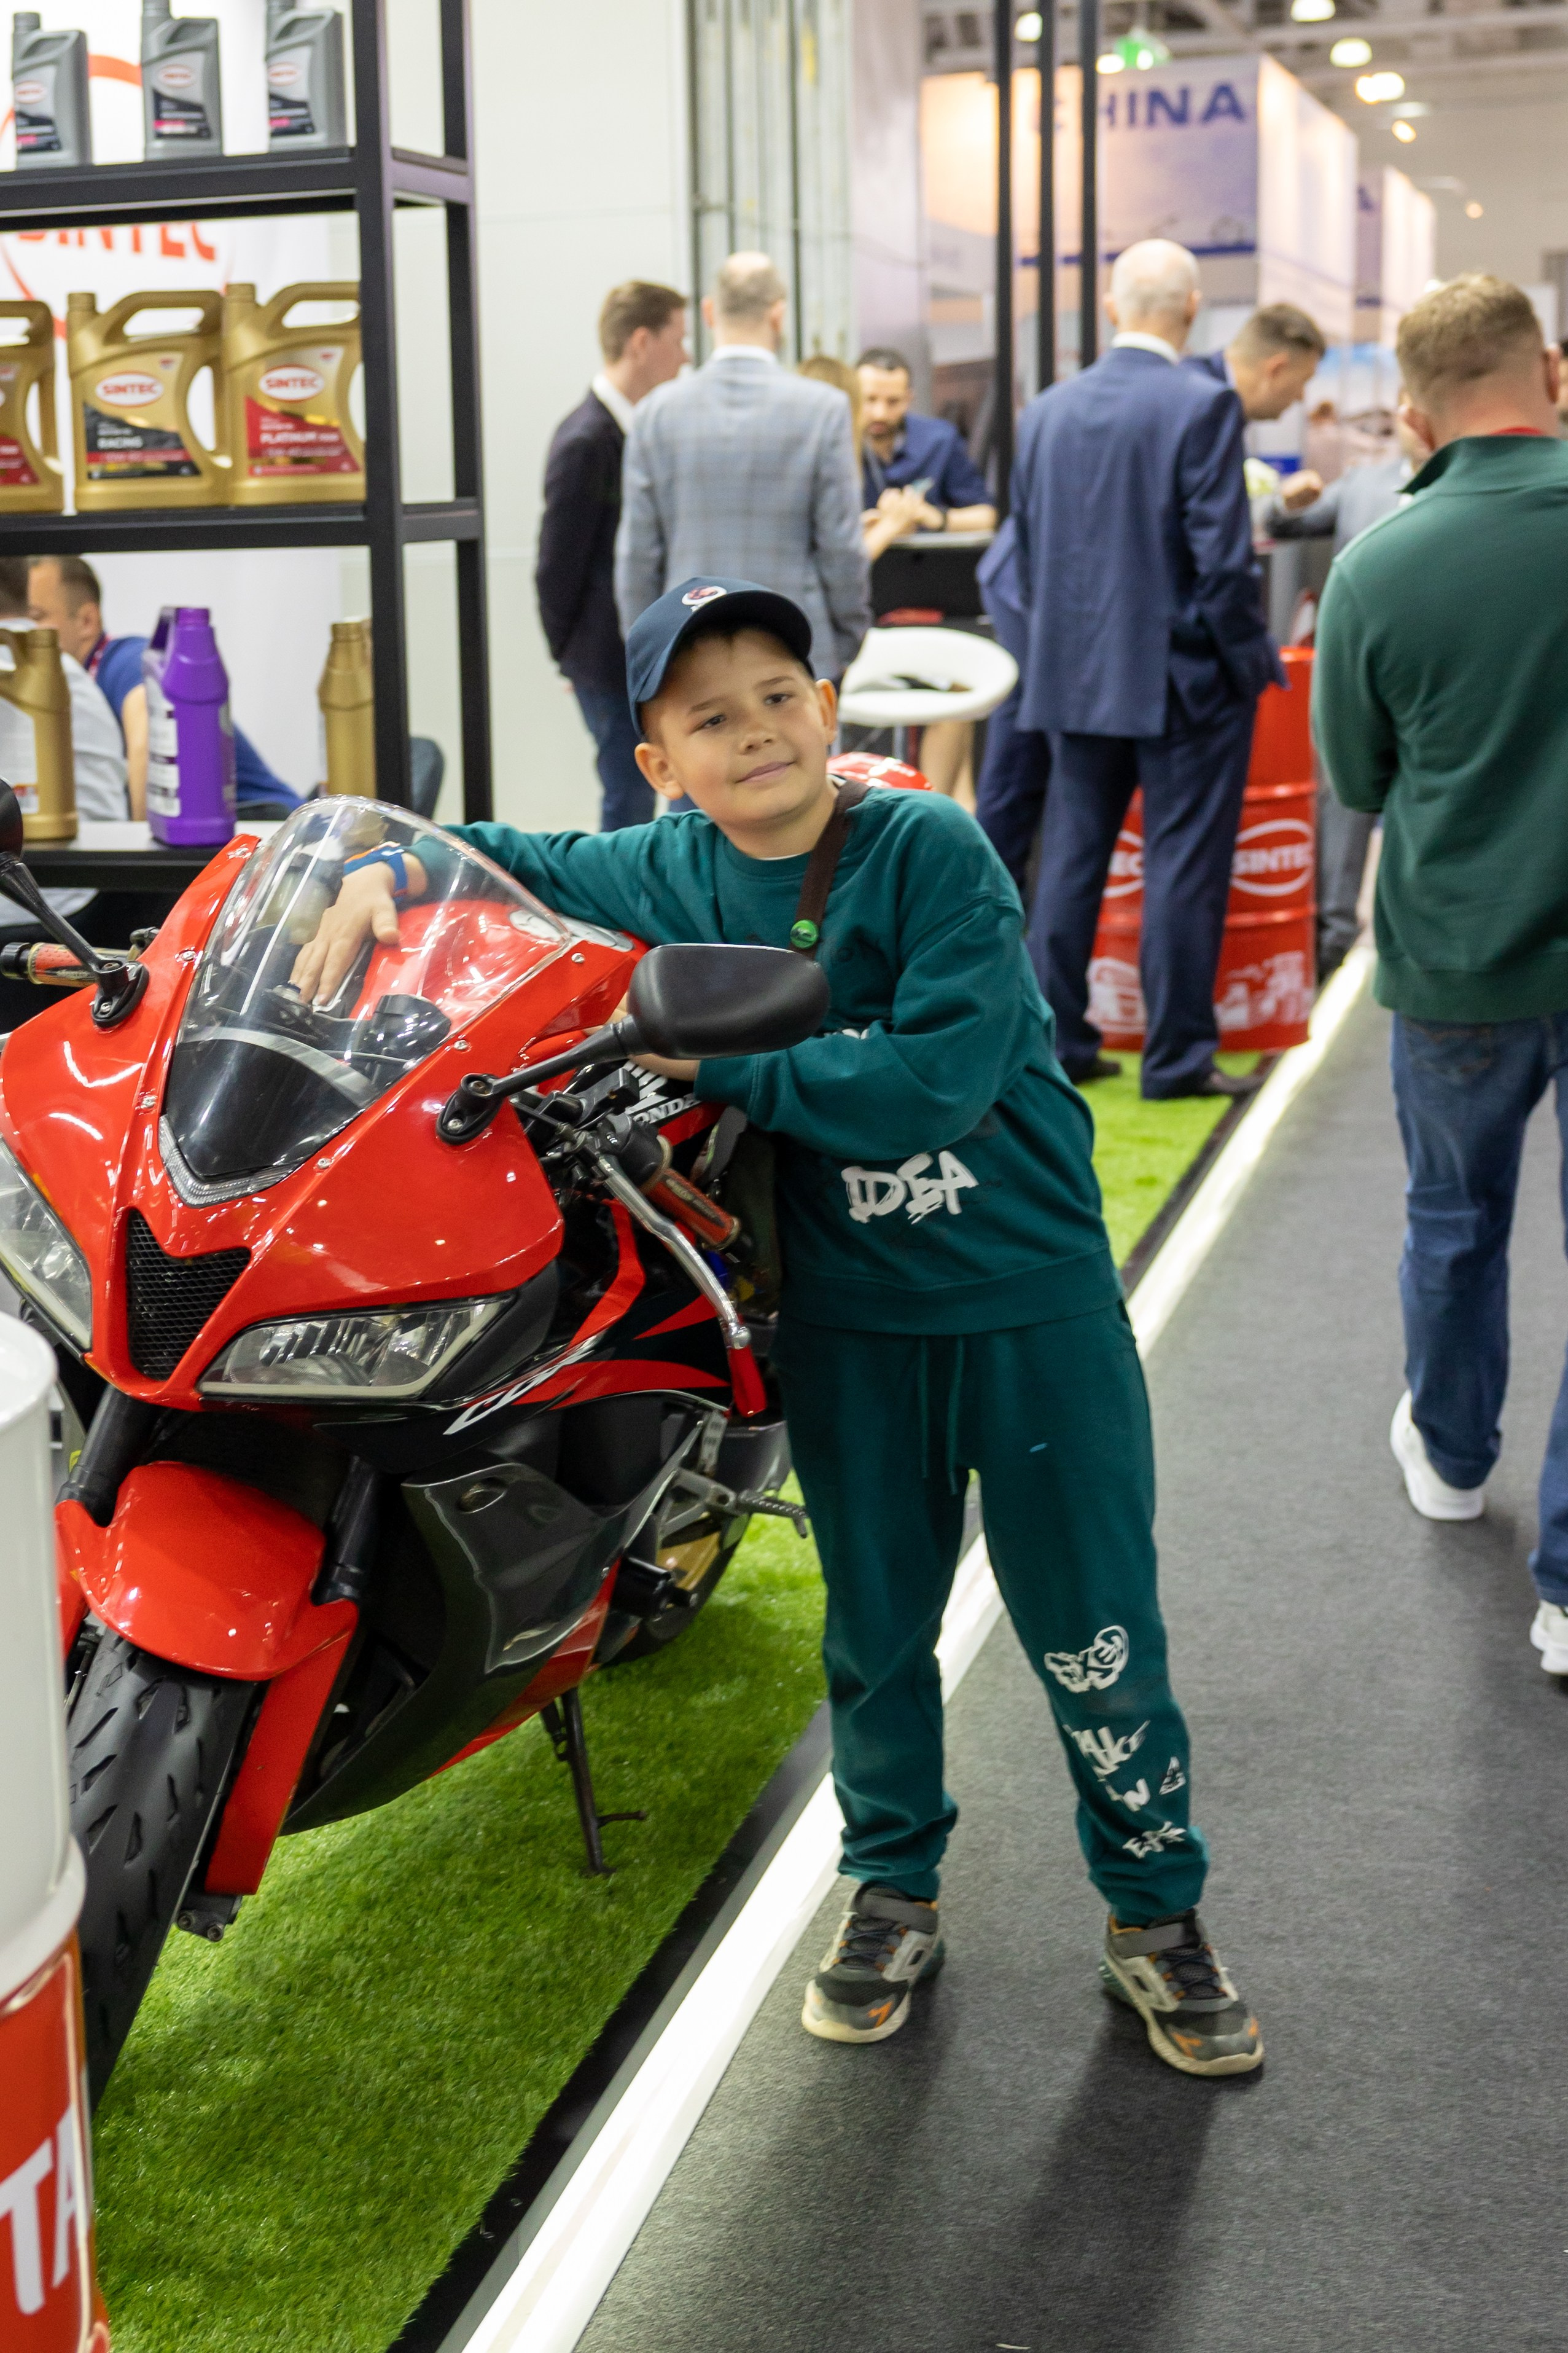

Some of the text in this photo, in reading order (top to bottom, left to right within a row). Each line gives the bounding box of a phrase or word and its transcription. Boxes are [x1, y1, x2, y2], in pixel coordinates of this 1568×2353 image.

[102, 382, 156, 395] SINTEC
[265, 377, 318, 390] SINTEC
[633, 1091, 702, 1124] ONDA
[841, 1150, 979, 1224] IDEA
